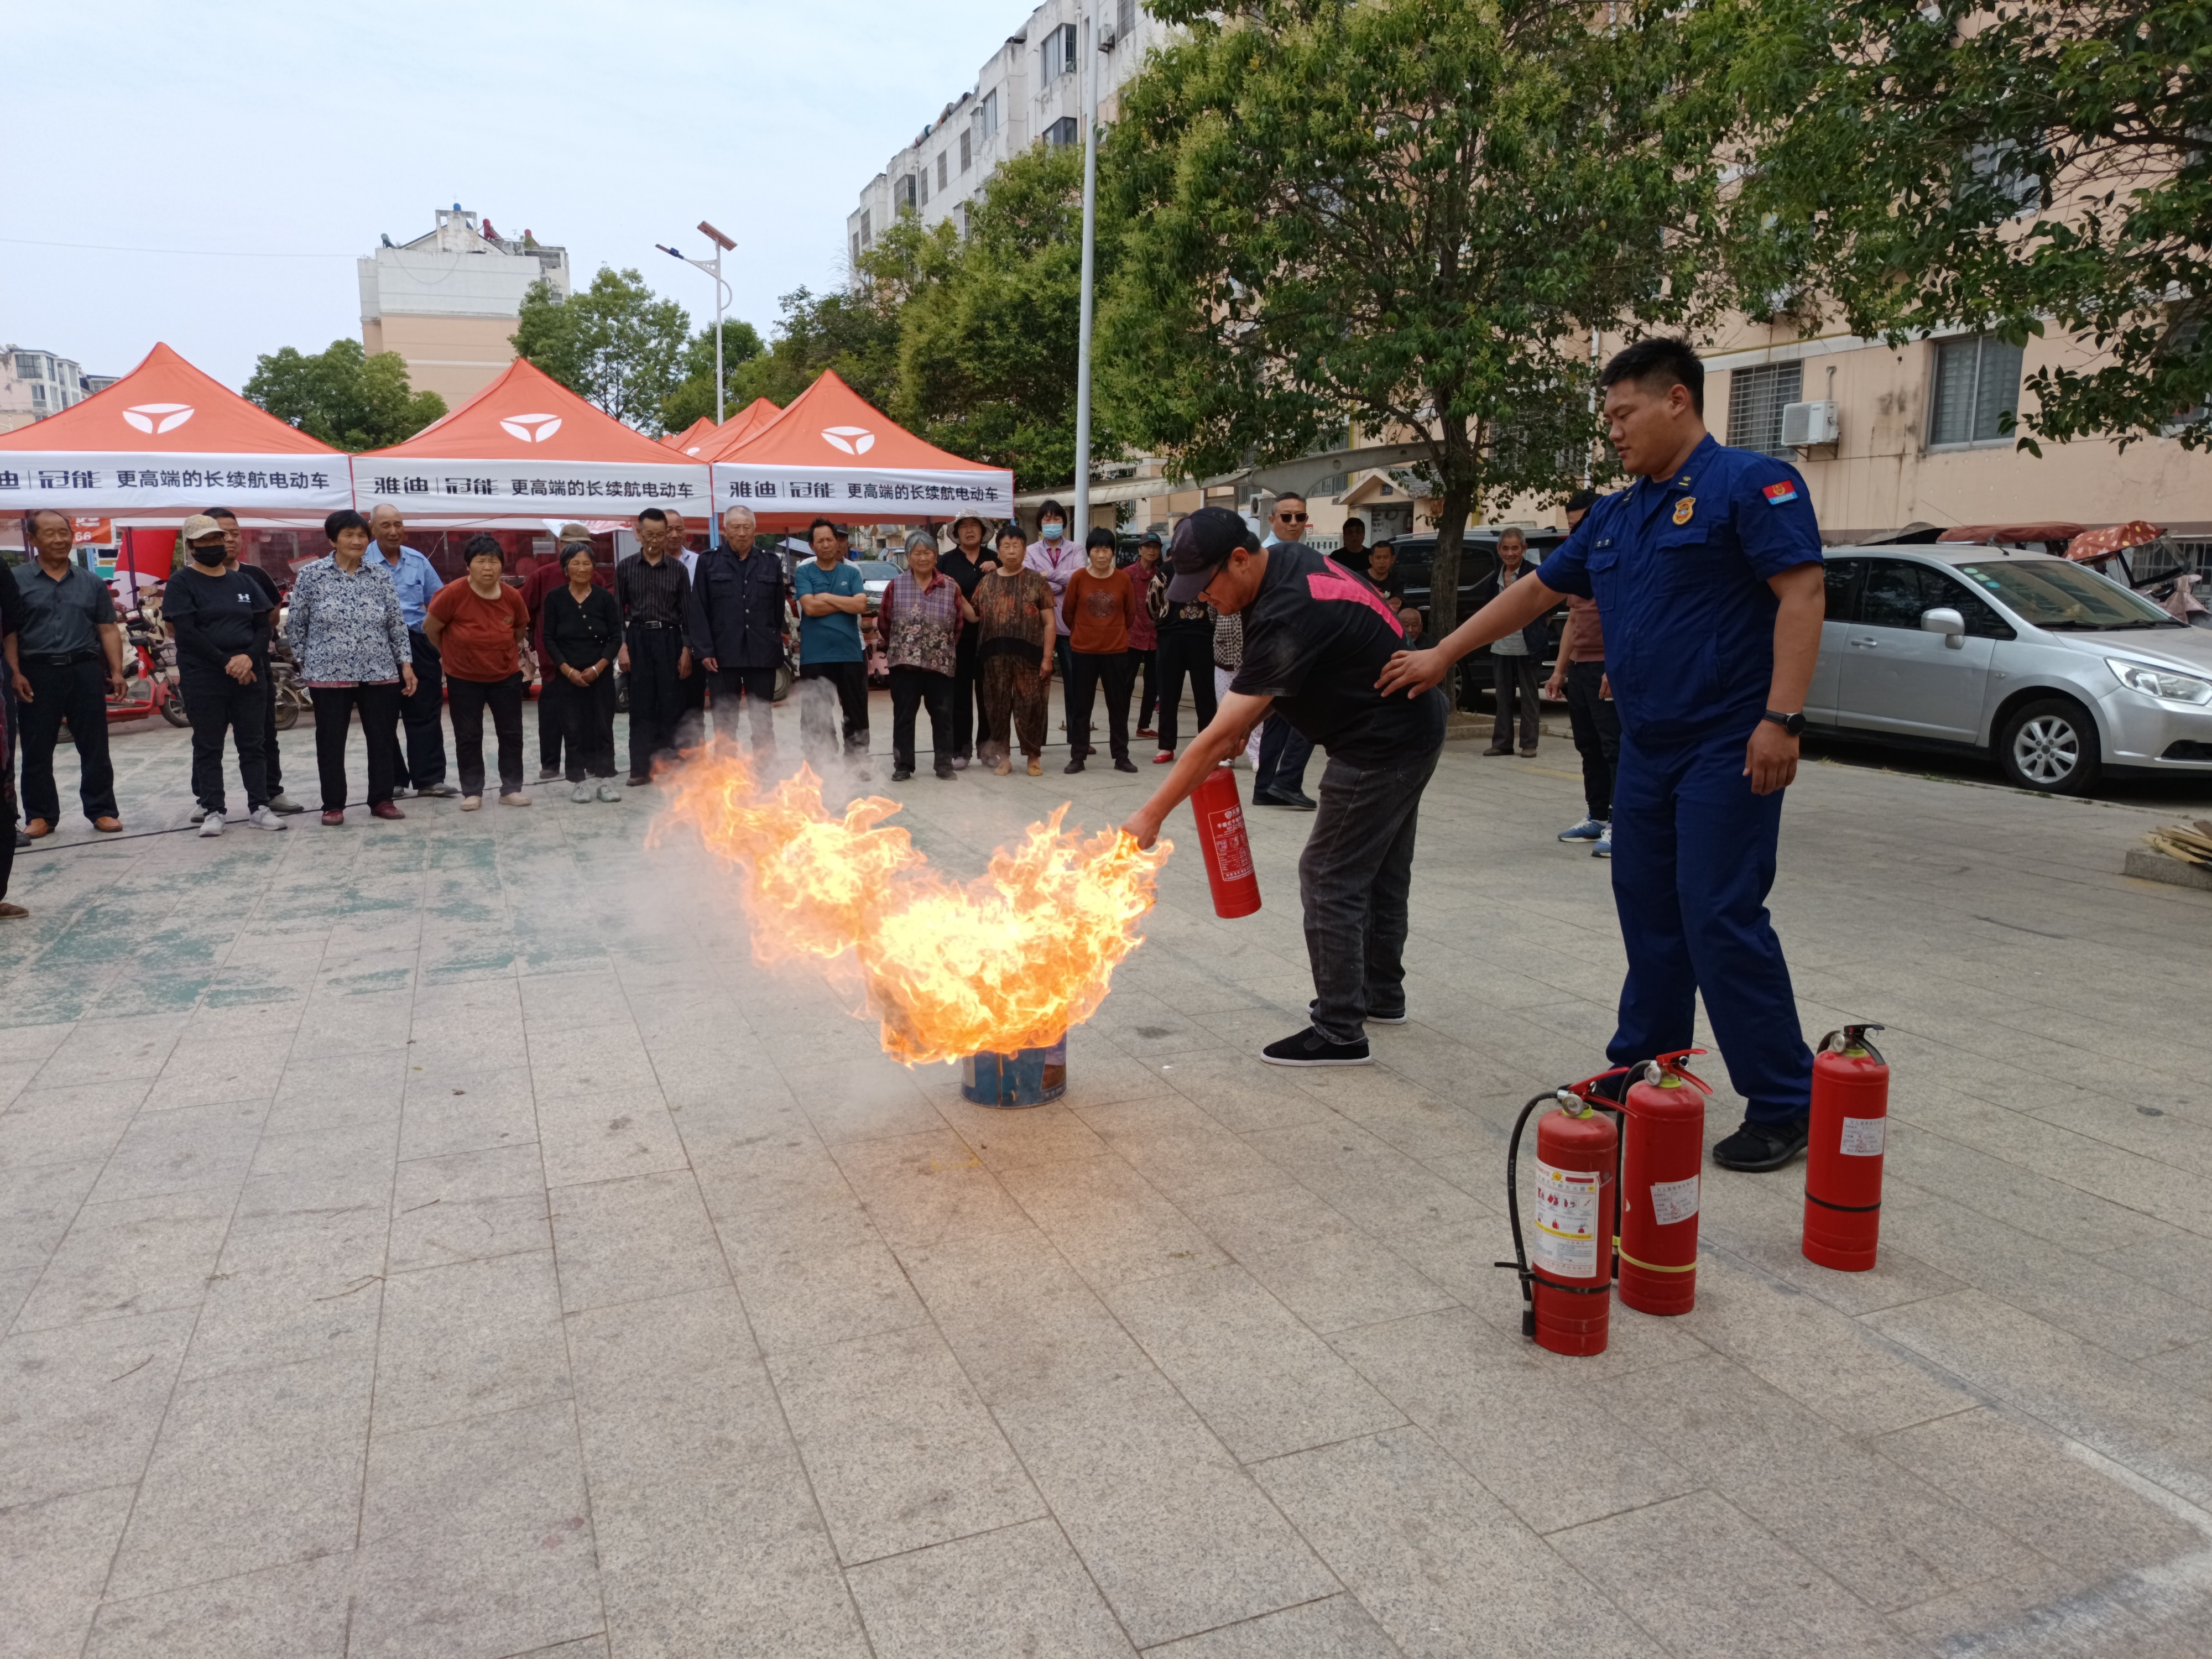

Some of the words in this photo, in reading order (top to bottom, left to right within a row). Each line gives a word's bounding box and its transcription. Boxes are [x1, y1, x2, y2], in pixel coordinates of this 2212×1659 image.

[38, 470, 102, 489] 冠能
[116, 469, 330, 489] 更高端的长续航电动车
[374, 476, 429, 494] 雅迪
[445, 477, 499, 495] 冠能
[510, 478, 694, 499] 更高端的长续航电动车
[729, 481, 777, 498] 雅迪
[789, 482, 836, 498] 冠能
[847, 483, 999, 502] 更高端的长续航电动车
